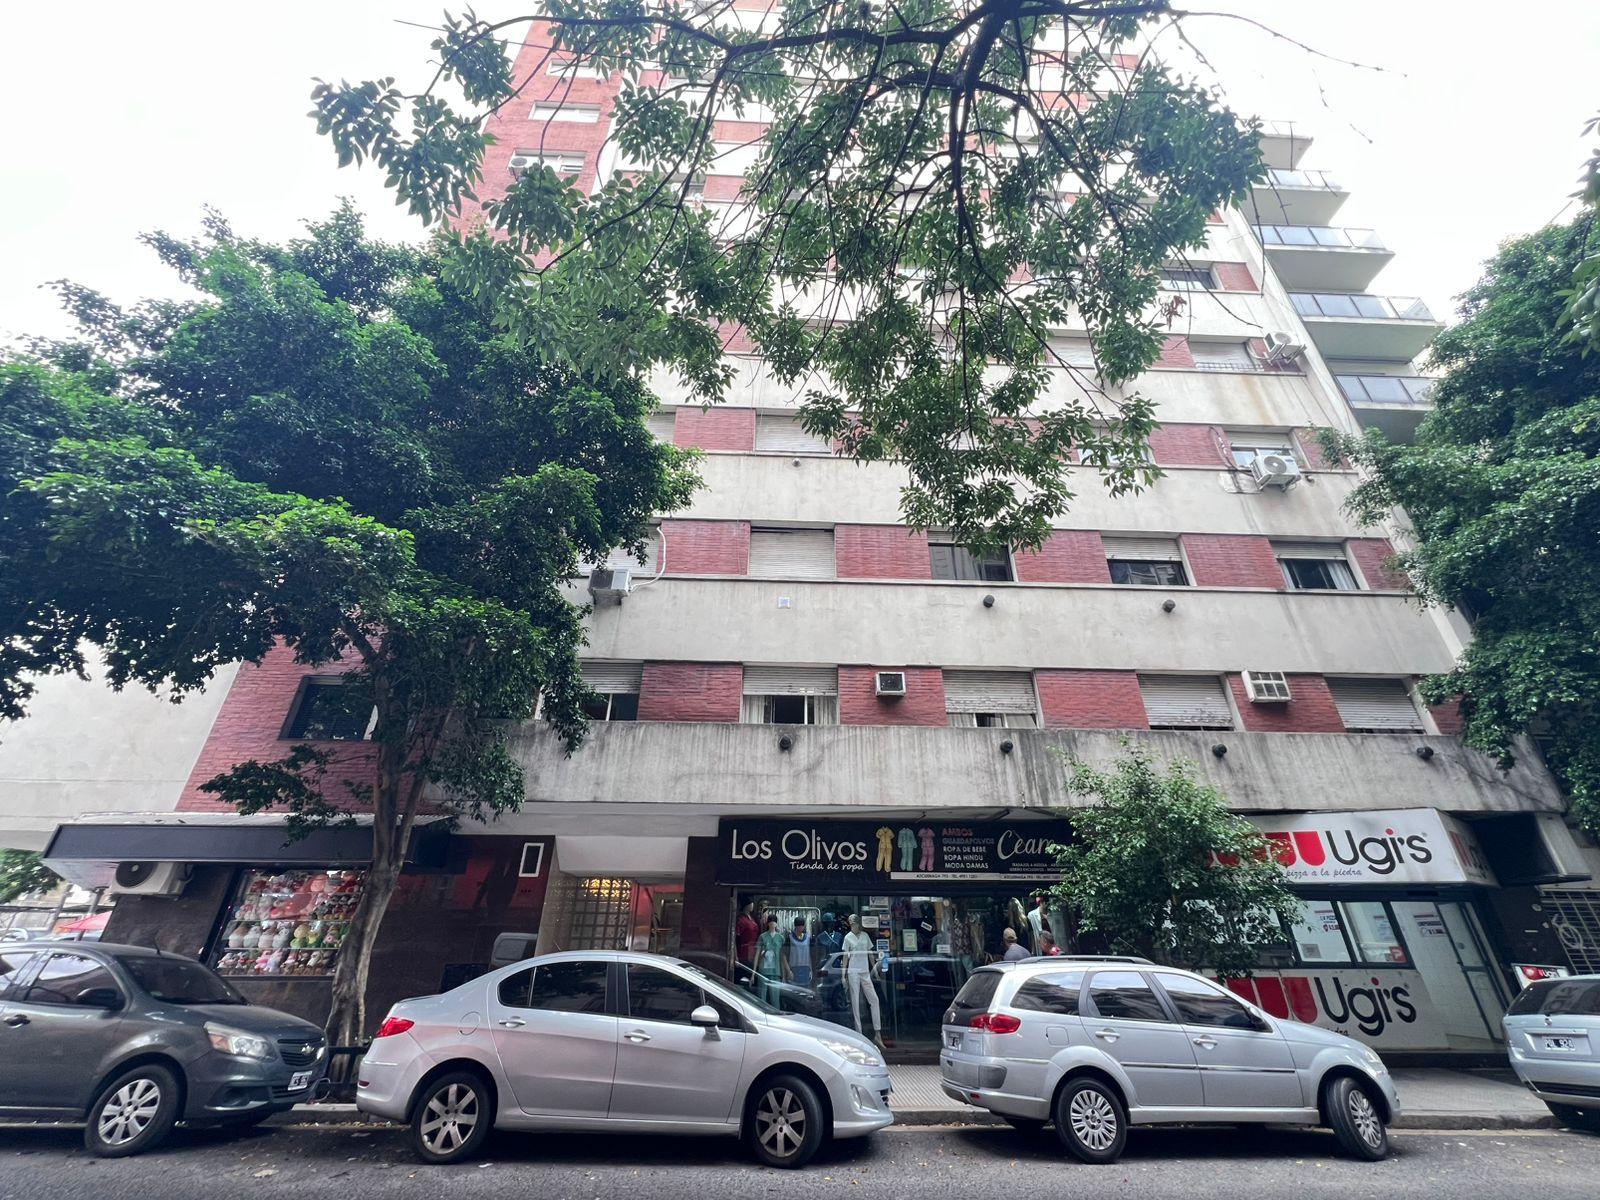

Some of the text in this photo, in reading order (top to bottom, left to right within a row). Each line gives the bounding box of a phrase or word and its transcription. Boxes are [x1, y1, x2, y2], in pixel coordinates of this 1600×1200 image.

[731, 829, 868, 861] Los Olivos
[943, 845, 961, 853] ROPA
[1325, 828, 1432, 875] Ugi's
[789, 862, 865, 873] Tienda de ropa
[1285, 867, 1362, 879] pizza a la piedra
[1313, 976, 1417, 1037] Ugi's
